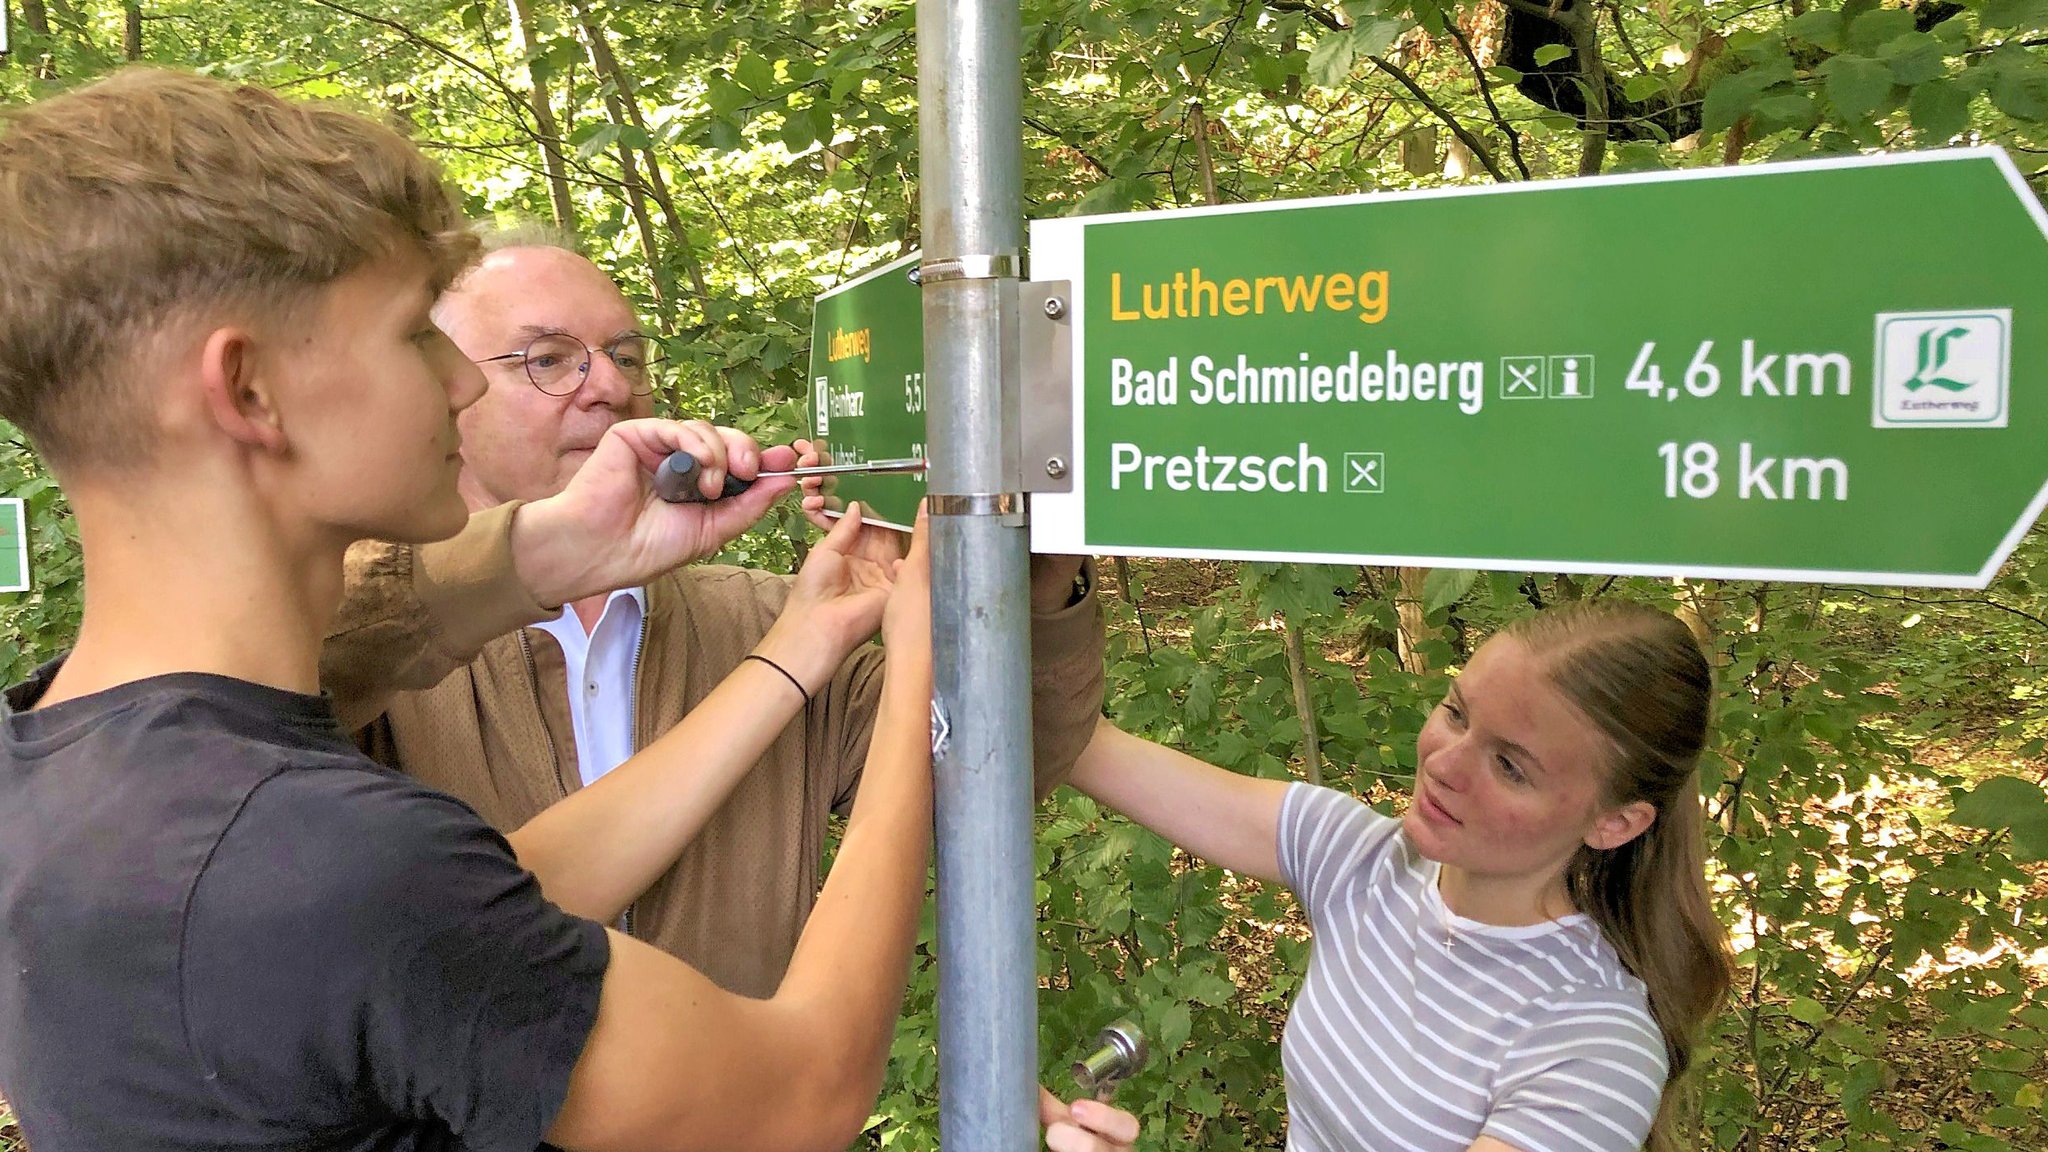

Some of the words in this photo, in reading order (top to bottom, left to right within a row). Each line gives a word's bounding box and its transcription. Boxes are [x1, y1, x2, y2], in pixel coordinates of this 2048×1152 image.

[1111, 268, 1390, 324] Lutherweg
[827, 326, 871, 364] Lutherweg
[829, 384, 864, 418] Reinharz
[905, 373, 922, 415] 5,5
[1111, 356, 1178, 406] Bad
[1190, 350, 1484, 415] Schmiedeberg
[1625, 340, 1720, 401] 4,6
[1741, 339, 1851, 396] km
[1111, 442, 1328, 493] Pretzsch
[1657, 442, 1719, 499] 18
[1739, 442, 1848, 500] km
